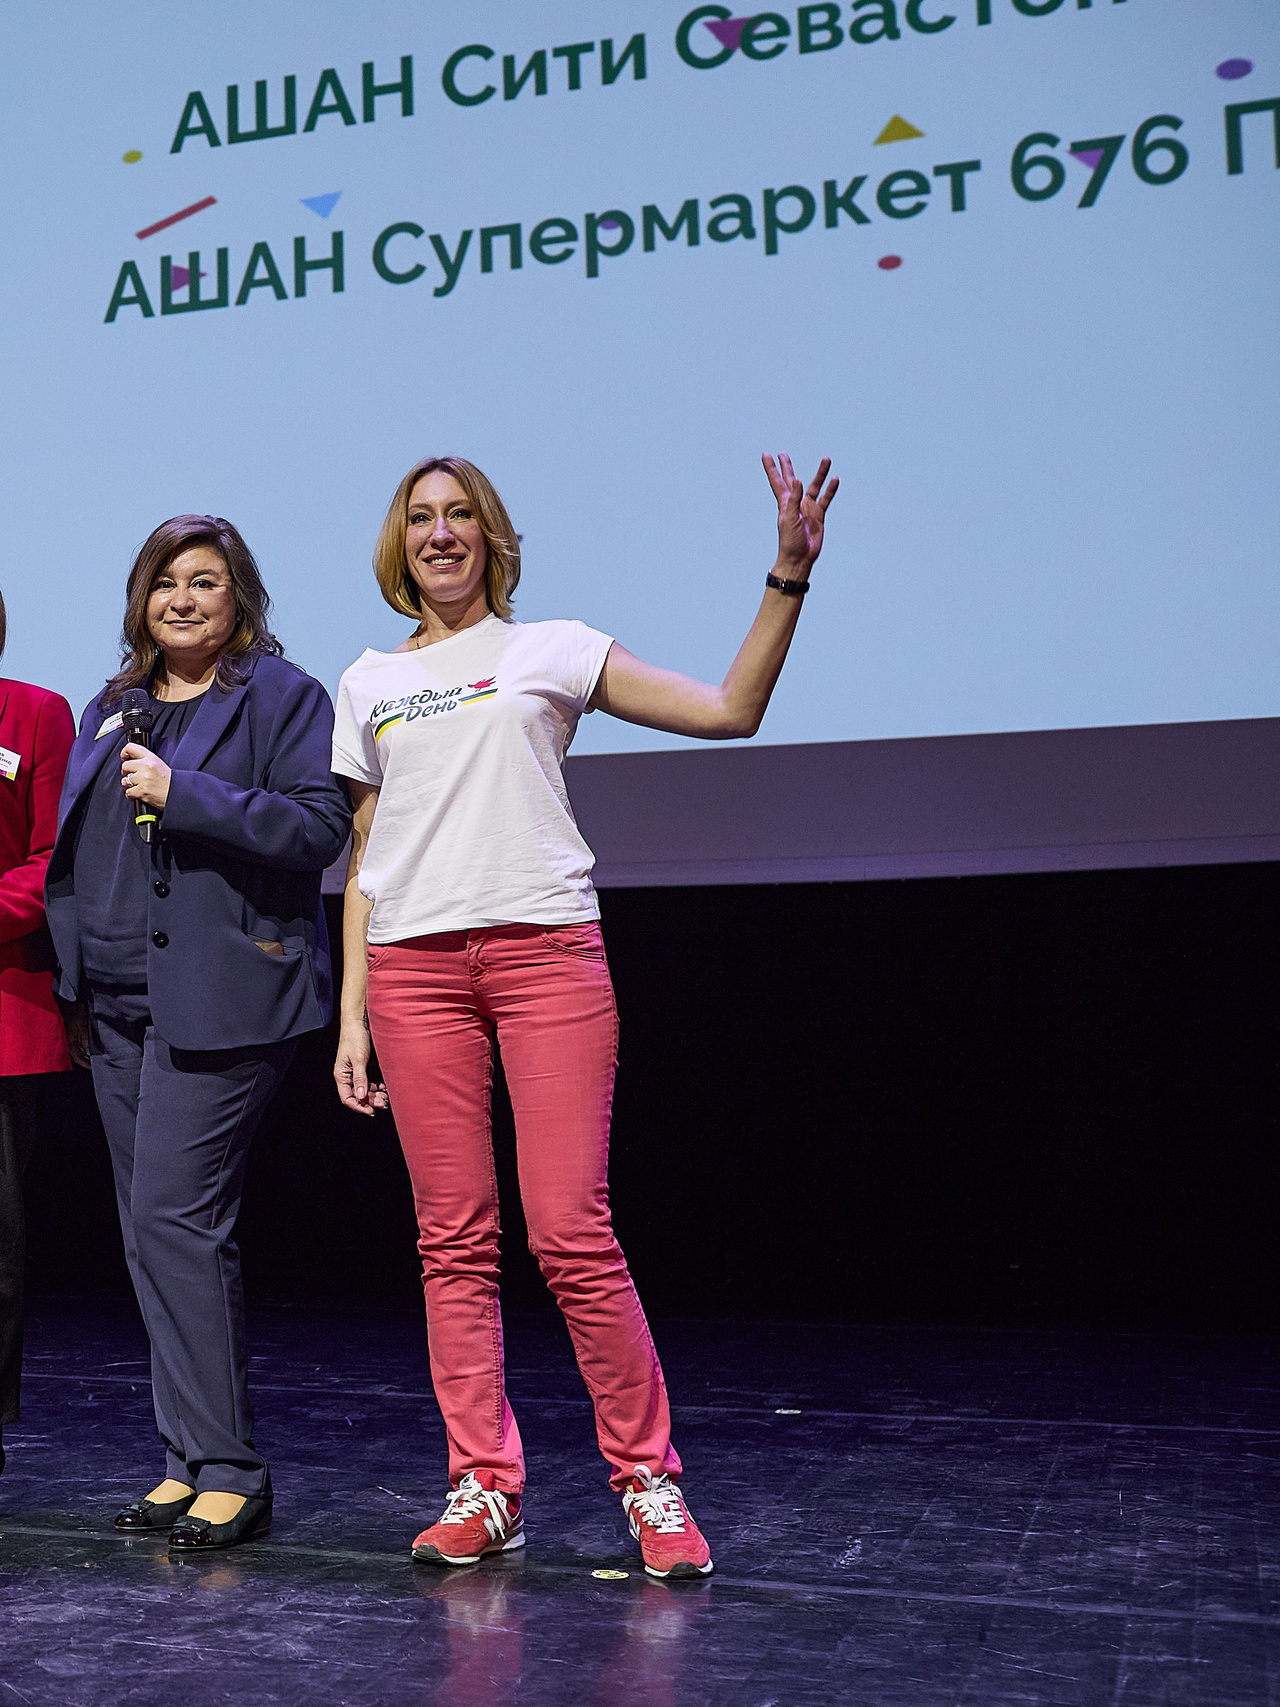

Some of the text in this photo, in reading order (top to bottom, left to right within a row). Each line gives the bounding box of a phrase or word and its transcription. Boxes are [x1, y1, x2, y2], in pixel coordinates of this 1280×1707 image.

[170, 0, 1121, 154] АШАН Сити Севас
[104, 231, 345, 323] АШАН
[372, 159, 982, 298] Супермаркет
[1010, 114, 1189, 209] 676
